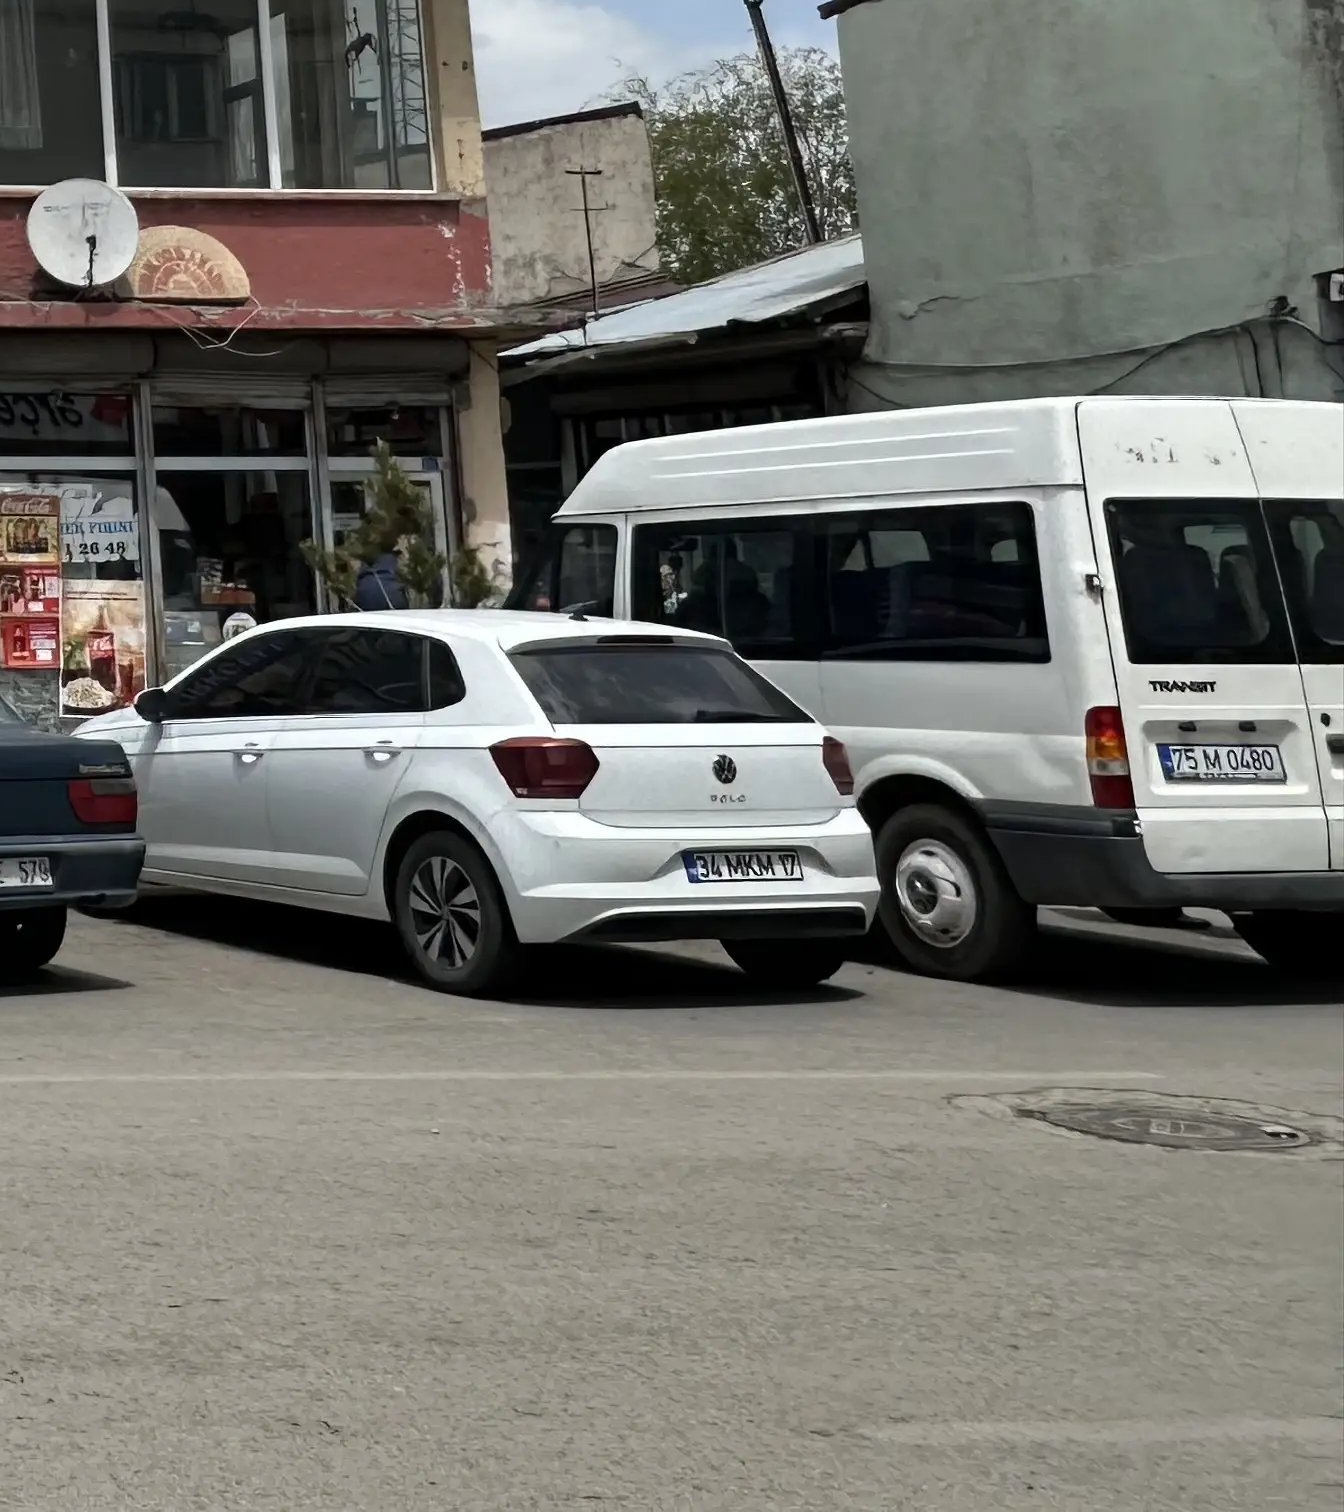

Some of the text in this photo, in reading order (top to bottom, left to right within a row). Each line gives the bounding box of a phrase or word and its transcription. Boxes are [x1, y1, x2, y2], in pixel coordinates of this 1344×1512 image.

[1148, 679, 1217, 693] TRANSIT
[1171, 748, 1274, 771] 75 M 0480
[724, 854, 776, 878] MKM
